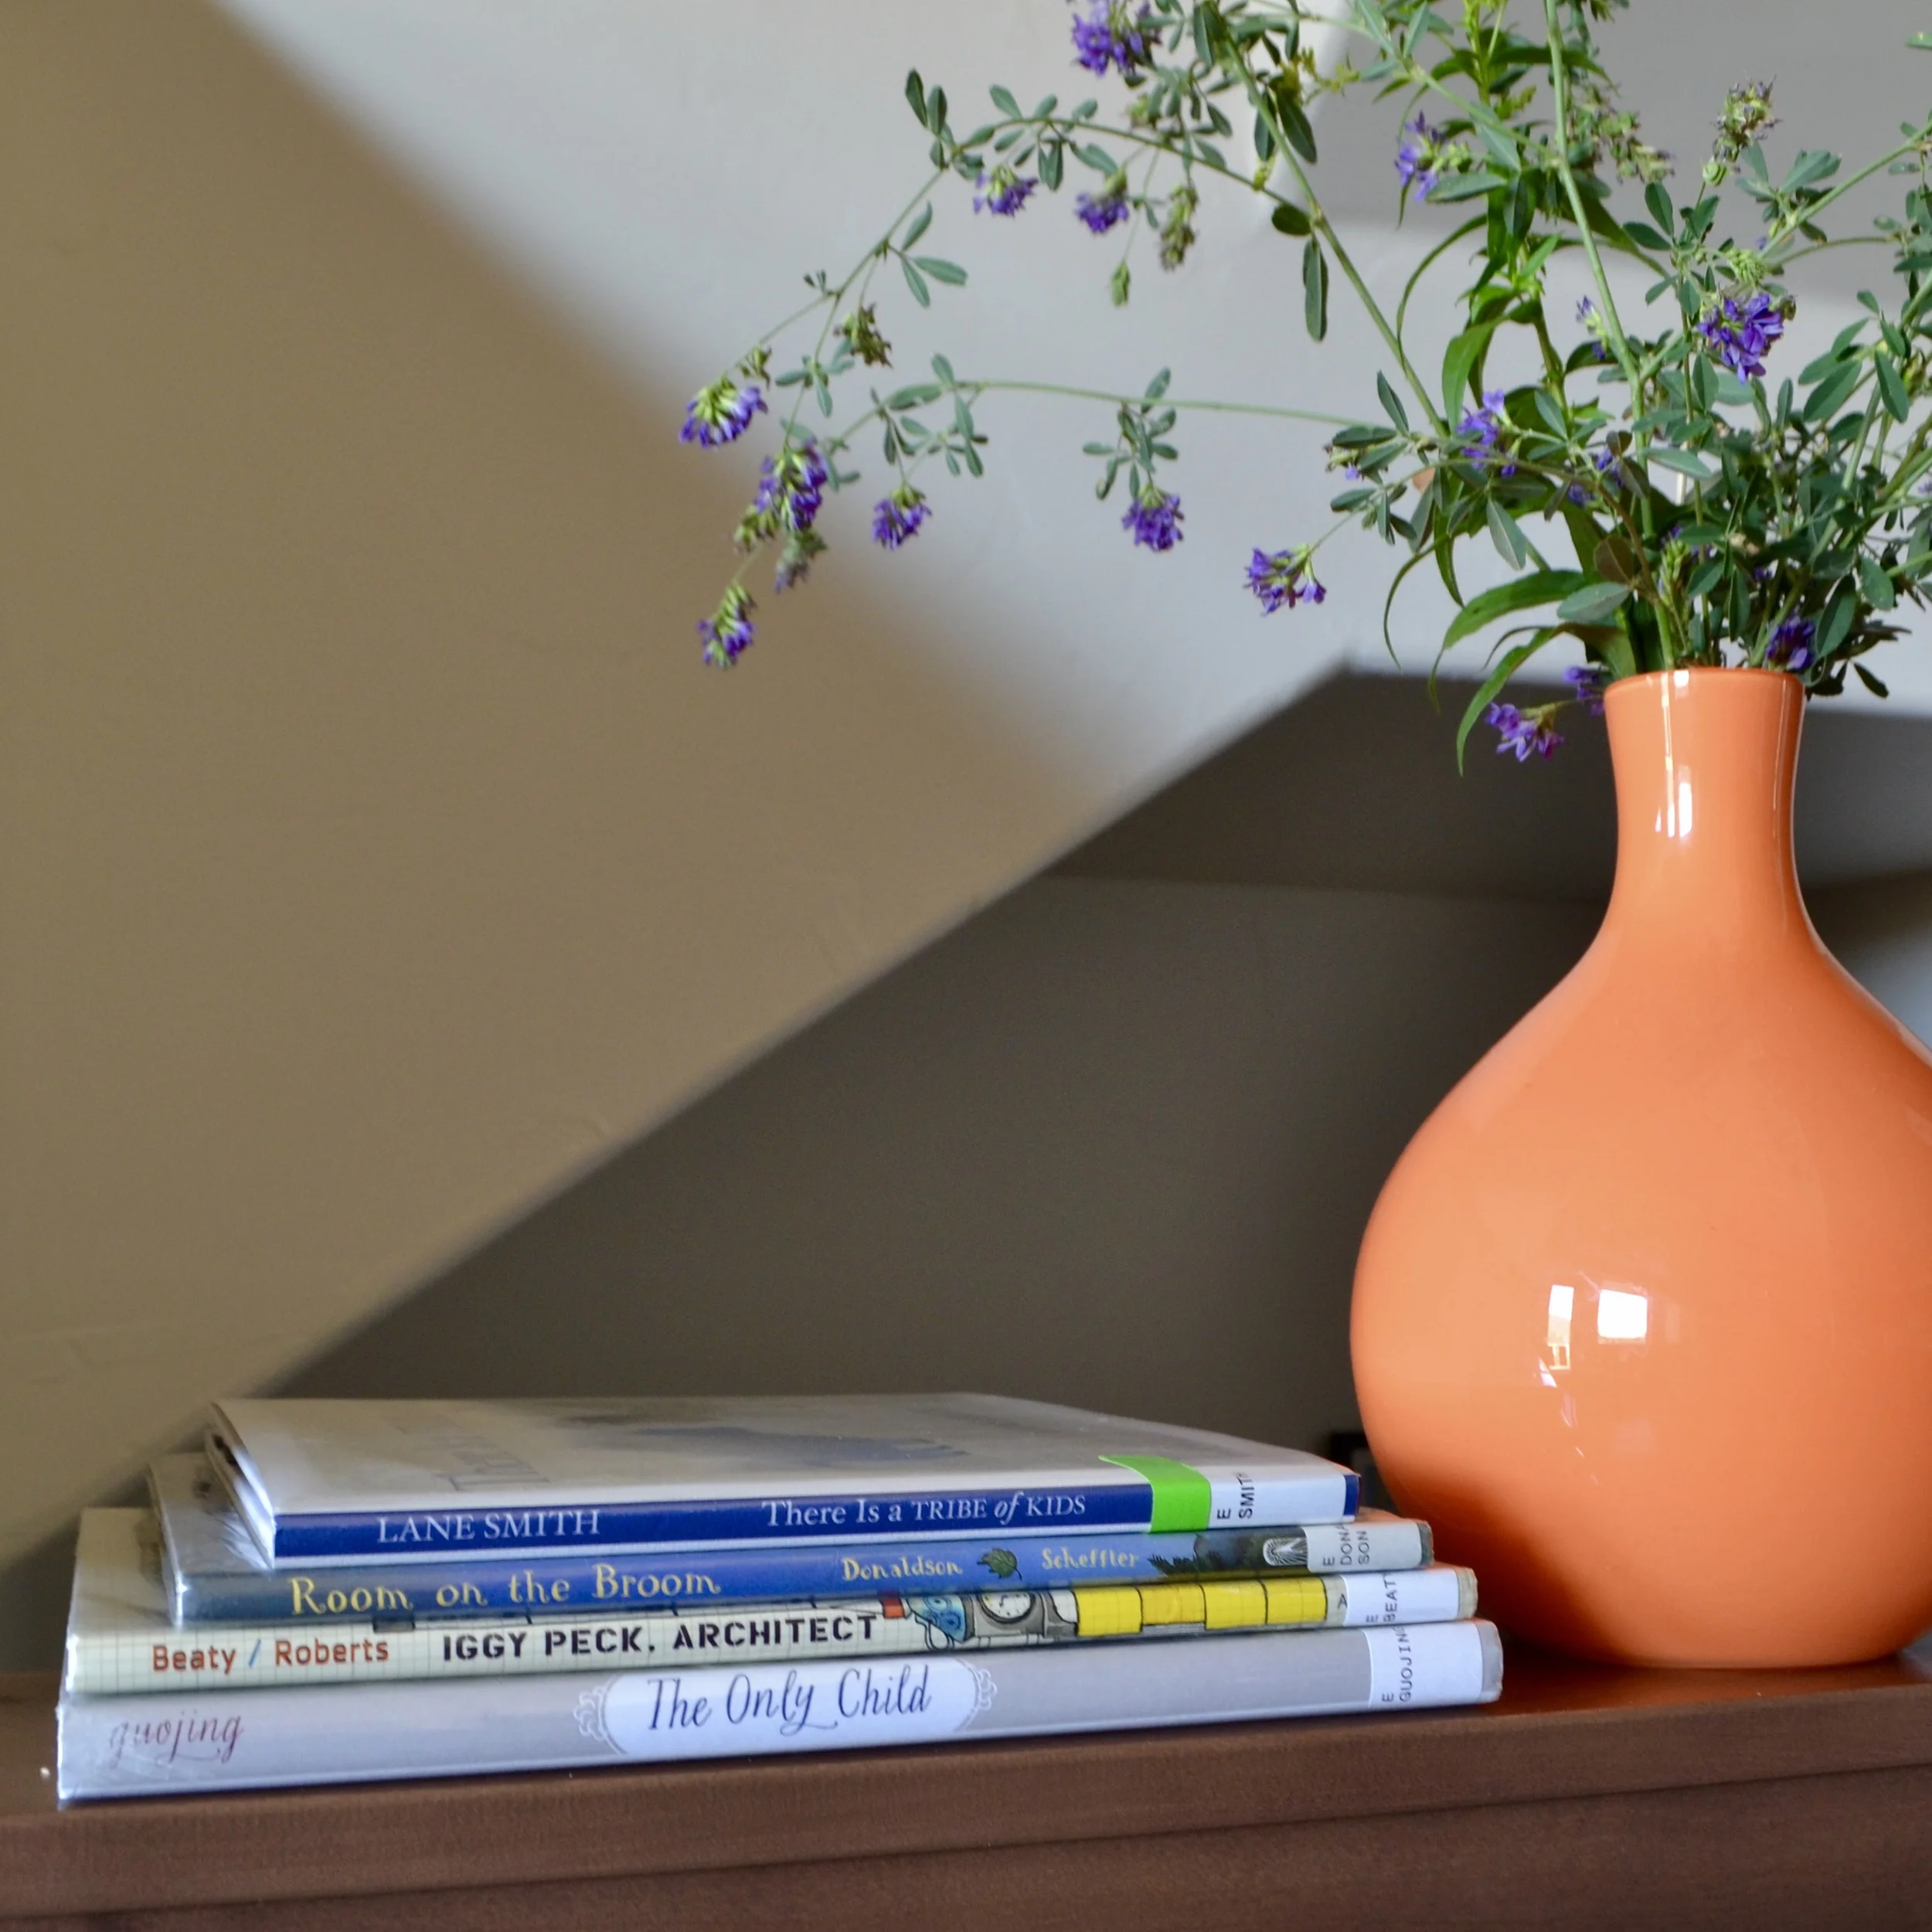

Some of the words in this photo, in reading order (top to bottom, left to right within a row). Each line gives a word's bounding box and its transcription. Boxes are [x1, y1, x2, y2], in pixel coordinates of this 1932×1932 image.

[376, 1515, 475, 1544] LANE
[482, 1509, 600, 1540] SMITH
[761, 1498, 847, 1527] There
[857, 1498, 880, 1523] Is
[887, 1503, 903, 1521] a
[910, 1498, 987, 1521] TRIBE
[994, 1491, 1025, 1525] of
[1026, 1495, 1087, 1516] KIDS
[1216, 1509, 1232, 1519] E
[1041, 1546, 1141, 1570] Scheffler
[1323, 1556, 1335, 1566] E
[1356, 1530, 1370, 1566] SON
[841, 1555, 964, 1582] Donaldson
[287, 1576, 414, 1615] Room
[435, 1580, 488, 1607] on
[508, 1570, 570, 1604] the
[591, 1562, 722, 1598] Broom
[1382, 1573, 1398, 1622] BEAT
[1366, 1614, 1379, 1623] E
[444, 1631, 528, 1662] IGGY
[672, 1614, 878, 1650] ARCHITECT
[152, 1645, 237, 1675] Beaty
[274, 1638, 389, 1665] Roberts
[647, 1677, 713, 1730] The
[726, 1669, 838, 1736] Only
[837, 1663, 932, 1717] Child
[1382, 1692, 1394, 1702] E
[108, 1709, 243, 1770] guojing
